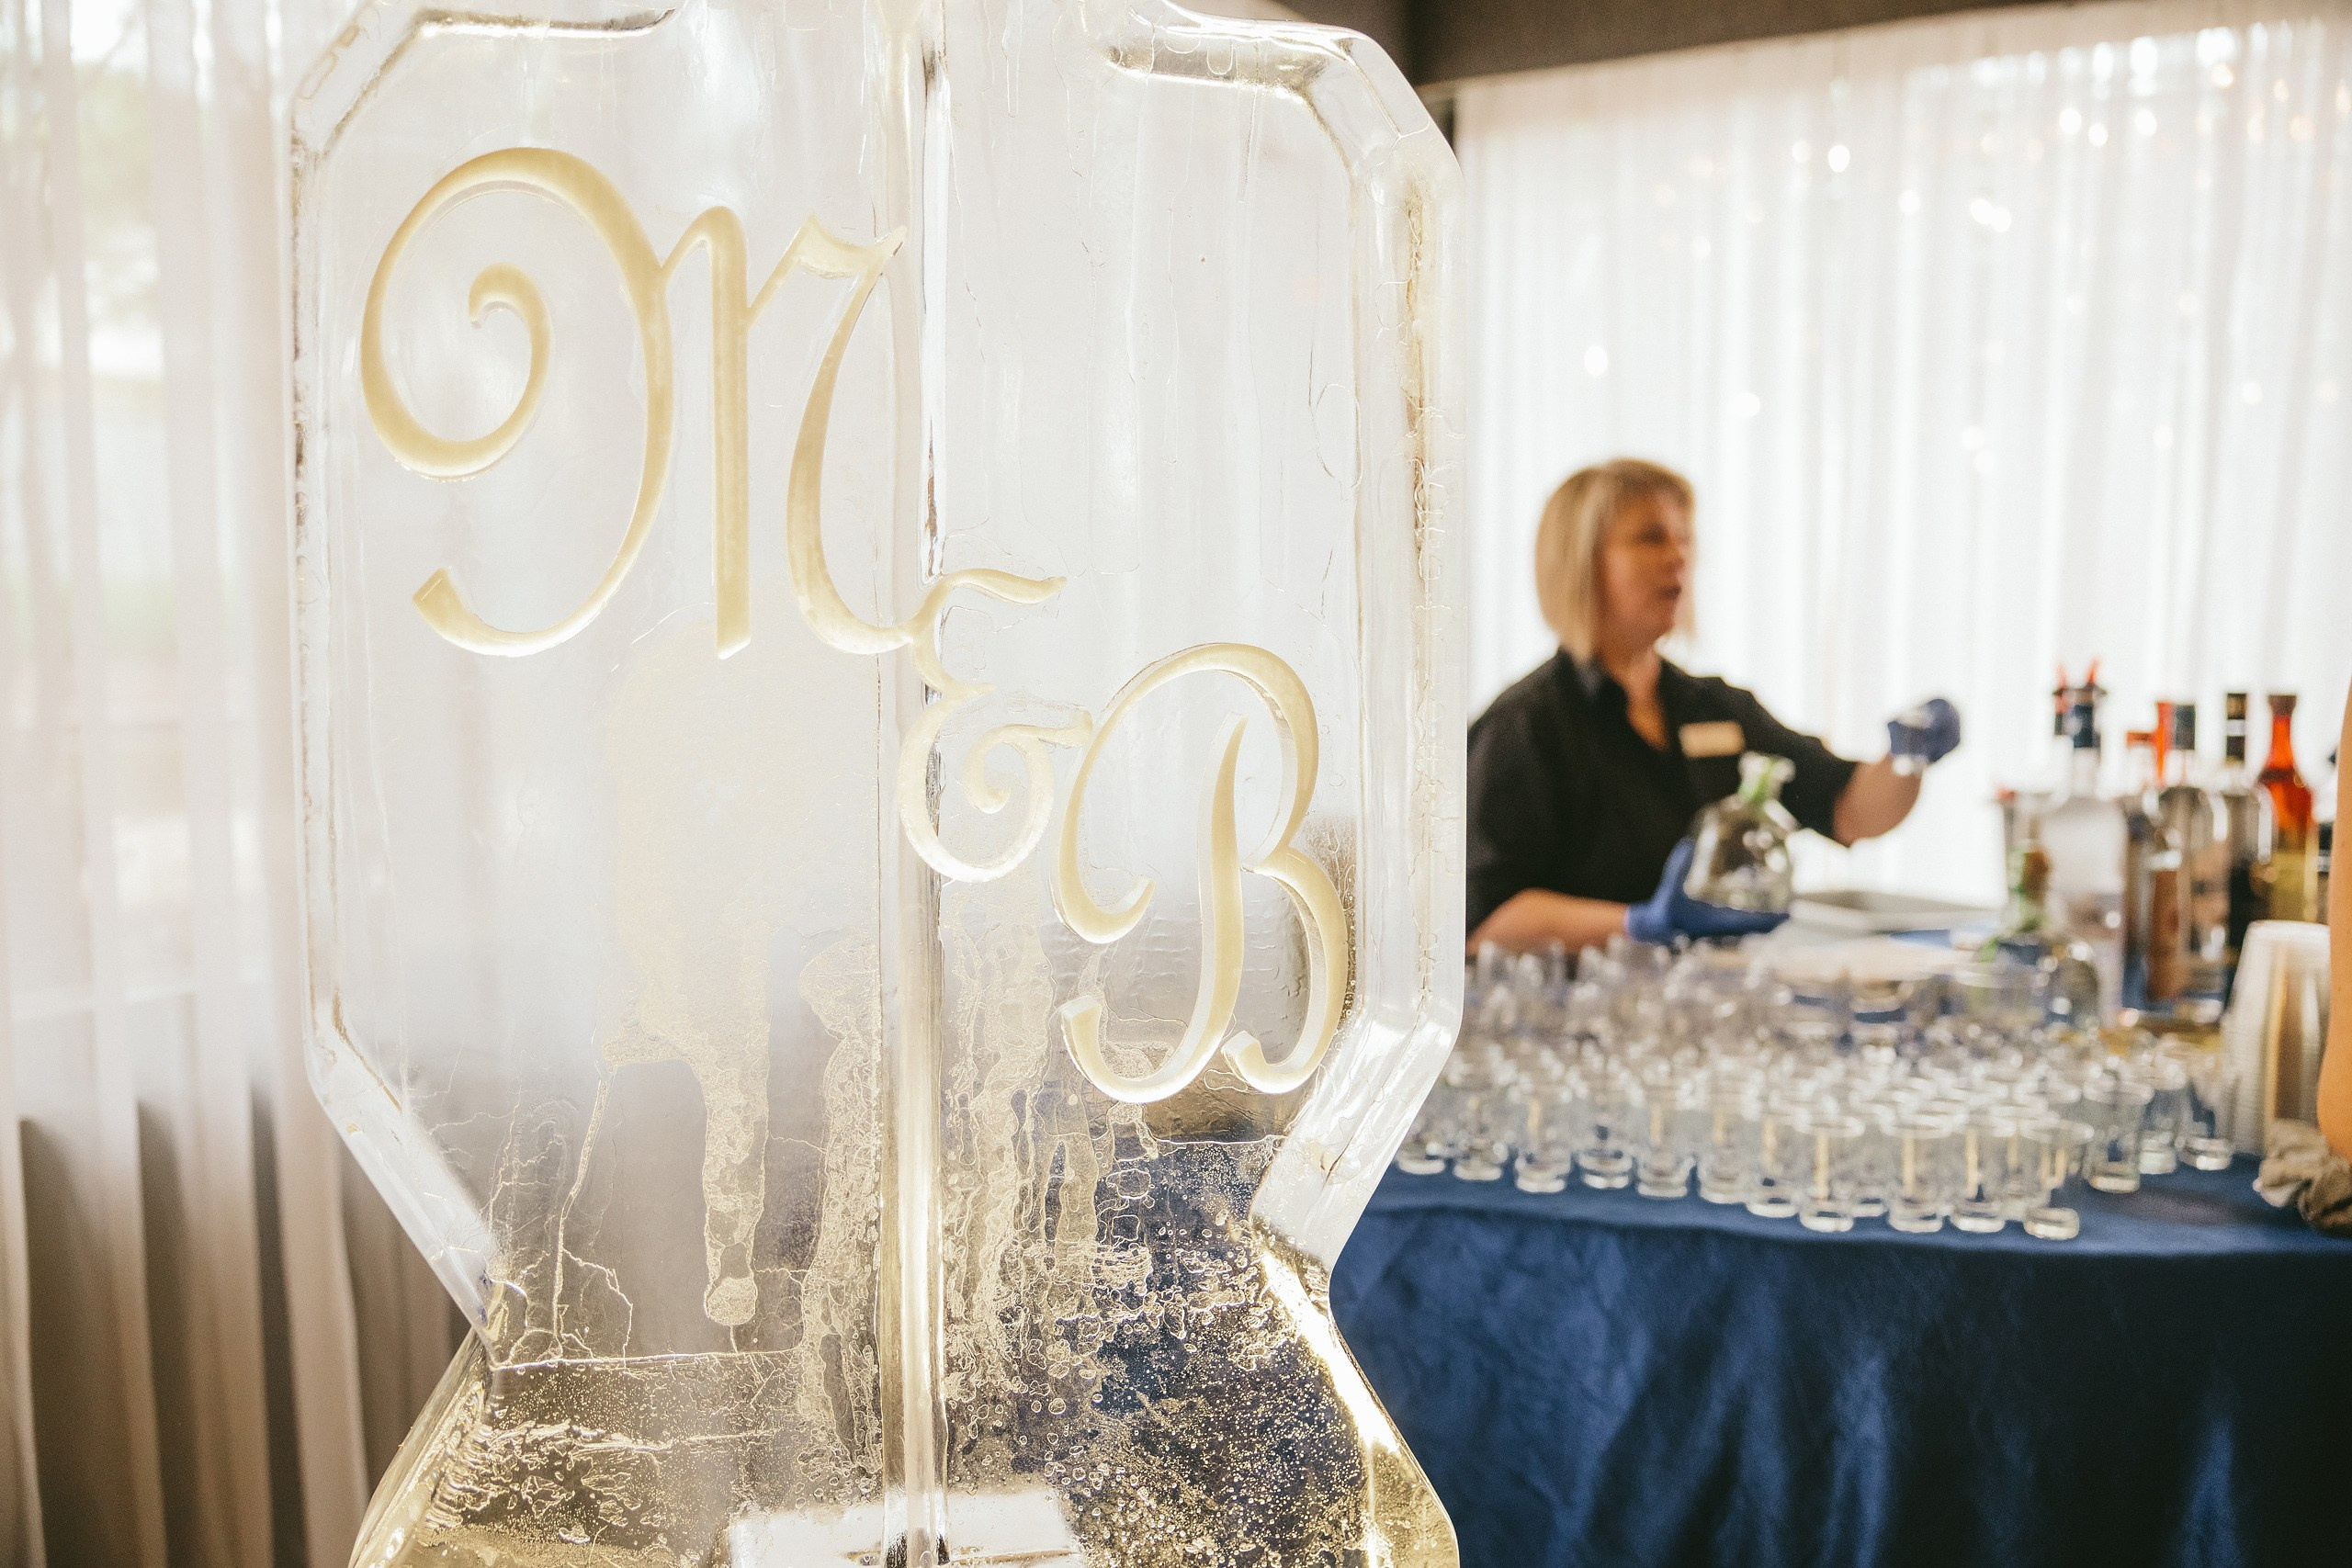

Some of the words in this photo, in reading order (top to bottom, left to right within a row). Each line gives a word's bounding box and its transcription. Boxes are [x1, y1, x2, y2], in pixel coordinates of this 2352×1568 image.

[359, 146, 911, 660] M
[897, 567, 1093, 883] &
[1055, 642, 1349, 1103] B
